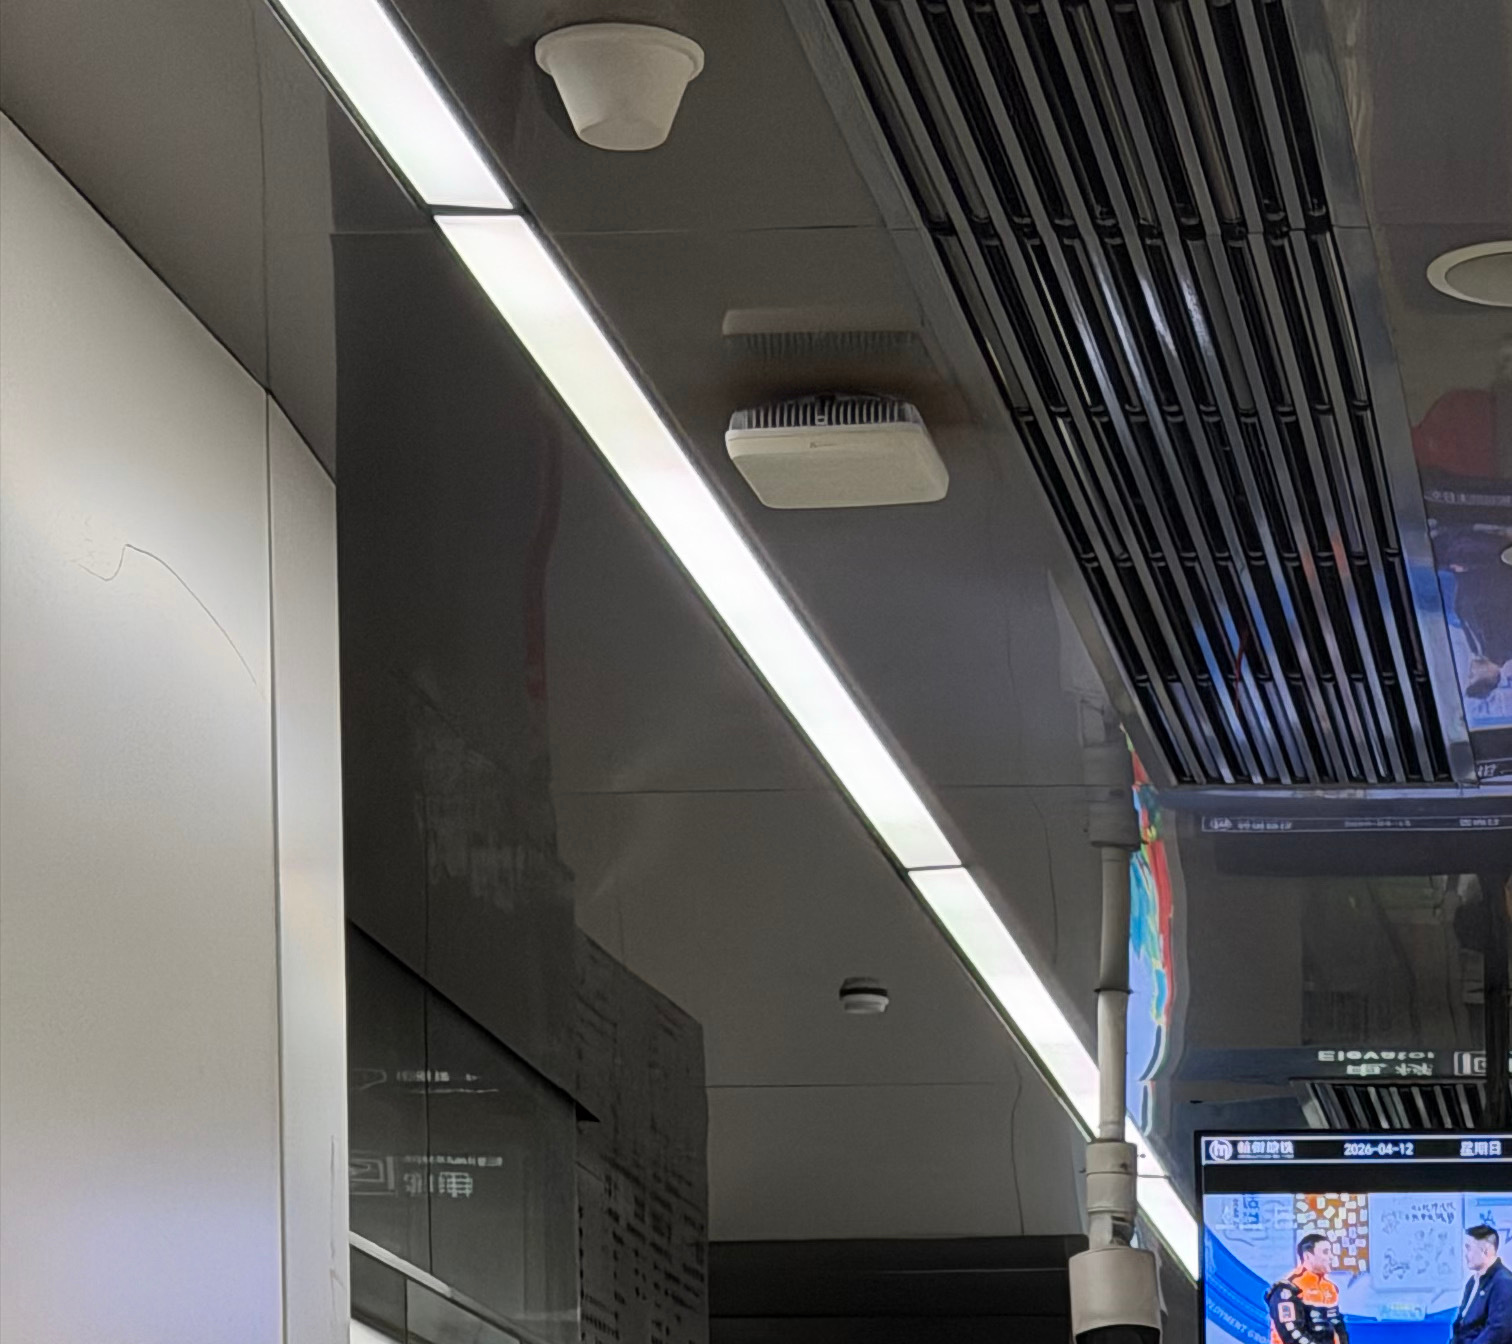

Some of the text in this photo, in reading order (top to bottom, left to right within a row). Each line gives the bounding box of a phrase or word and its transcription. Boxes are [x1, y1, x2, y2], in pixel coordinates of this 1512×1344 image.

[1343, 1143, 1414, 1156] 2026-04-12
[1459, 1140, 1502, 1157] 星期日
